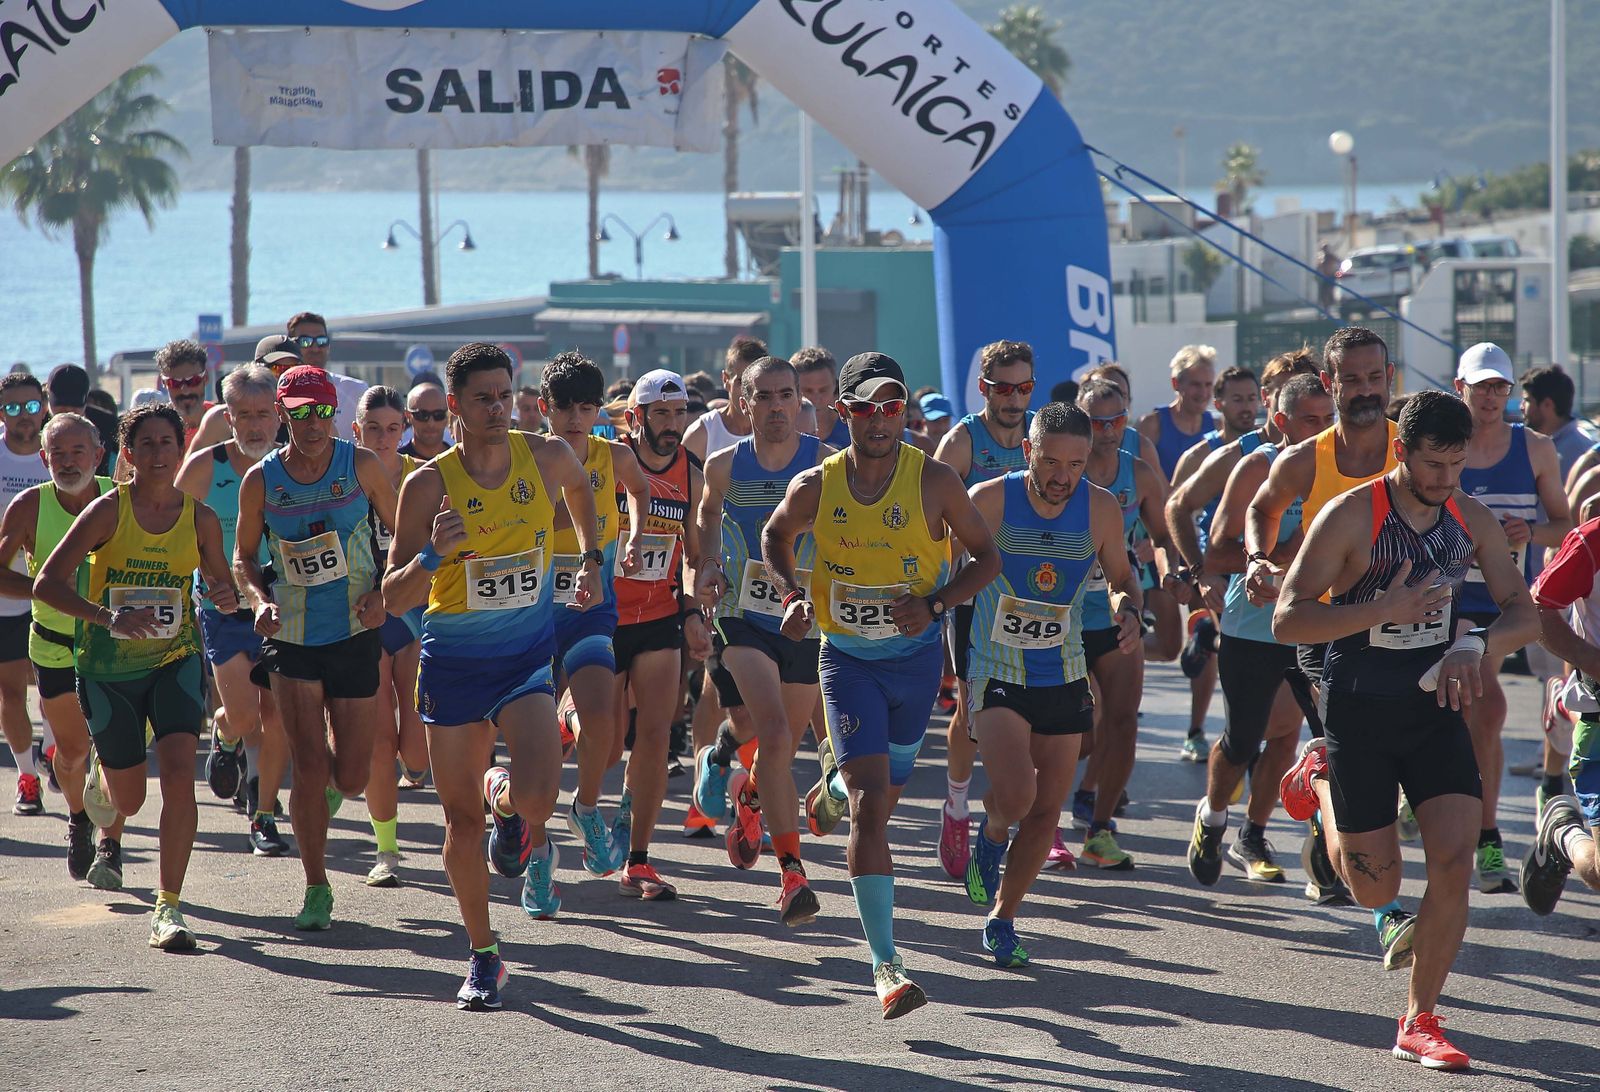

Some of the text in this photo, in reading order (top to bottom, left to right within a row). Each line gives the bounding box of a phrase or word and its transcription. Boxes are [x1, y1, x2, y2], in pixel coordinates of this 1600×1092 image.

[385, 67, 631, 113] SALIDA
[126, 558, 168, 570] RUNNERS
[289, 549, 338, 575] 156
[642, 550, 667, 569] 11
[477, 569, 538, 598] 315
[840, 602, 897, 625] 325
[1003, 613, 1061, 639] 349
